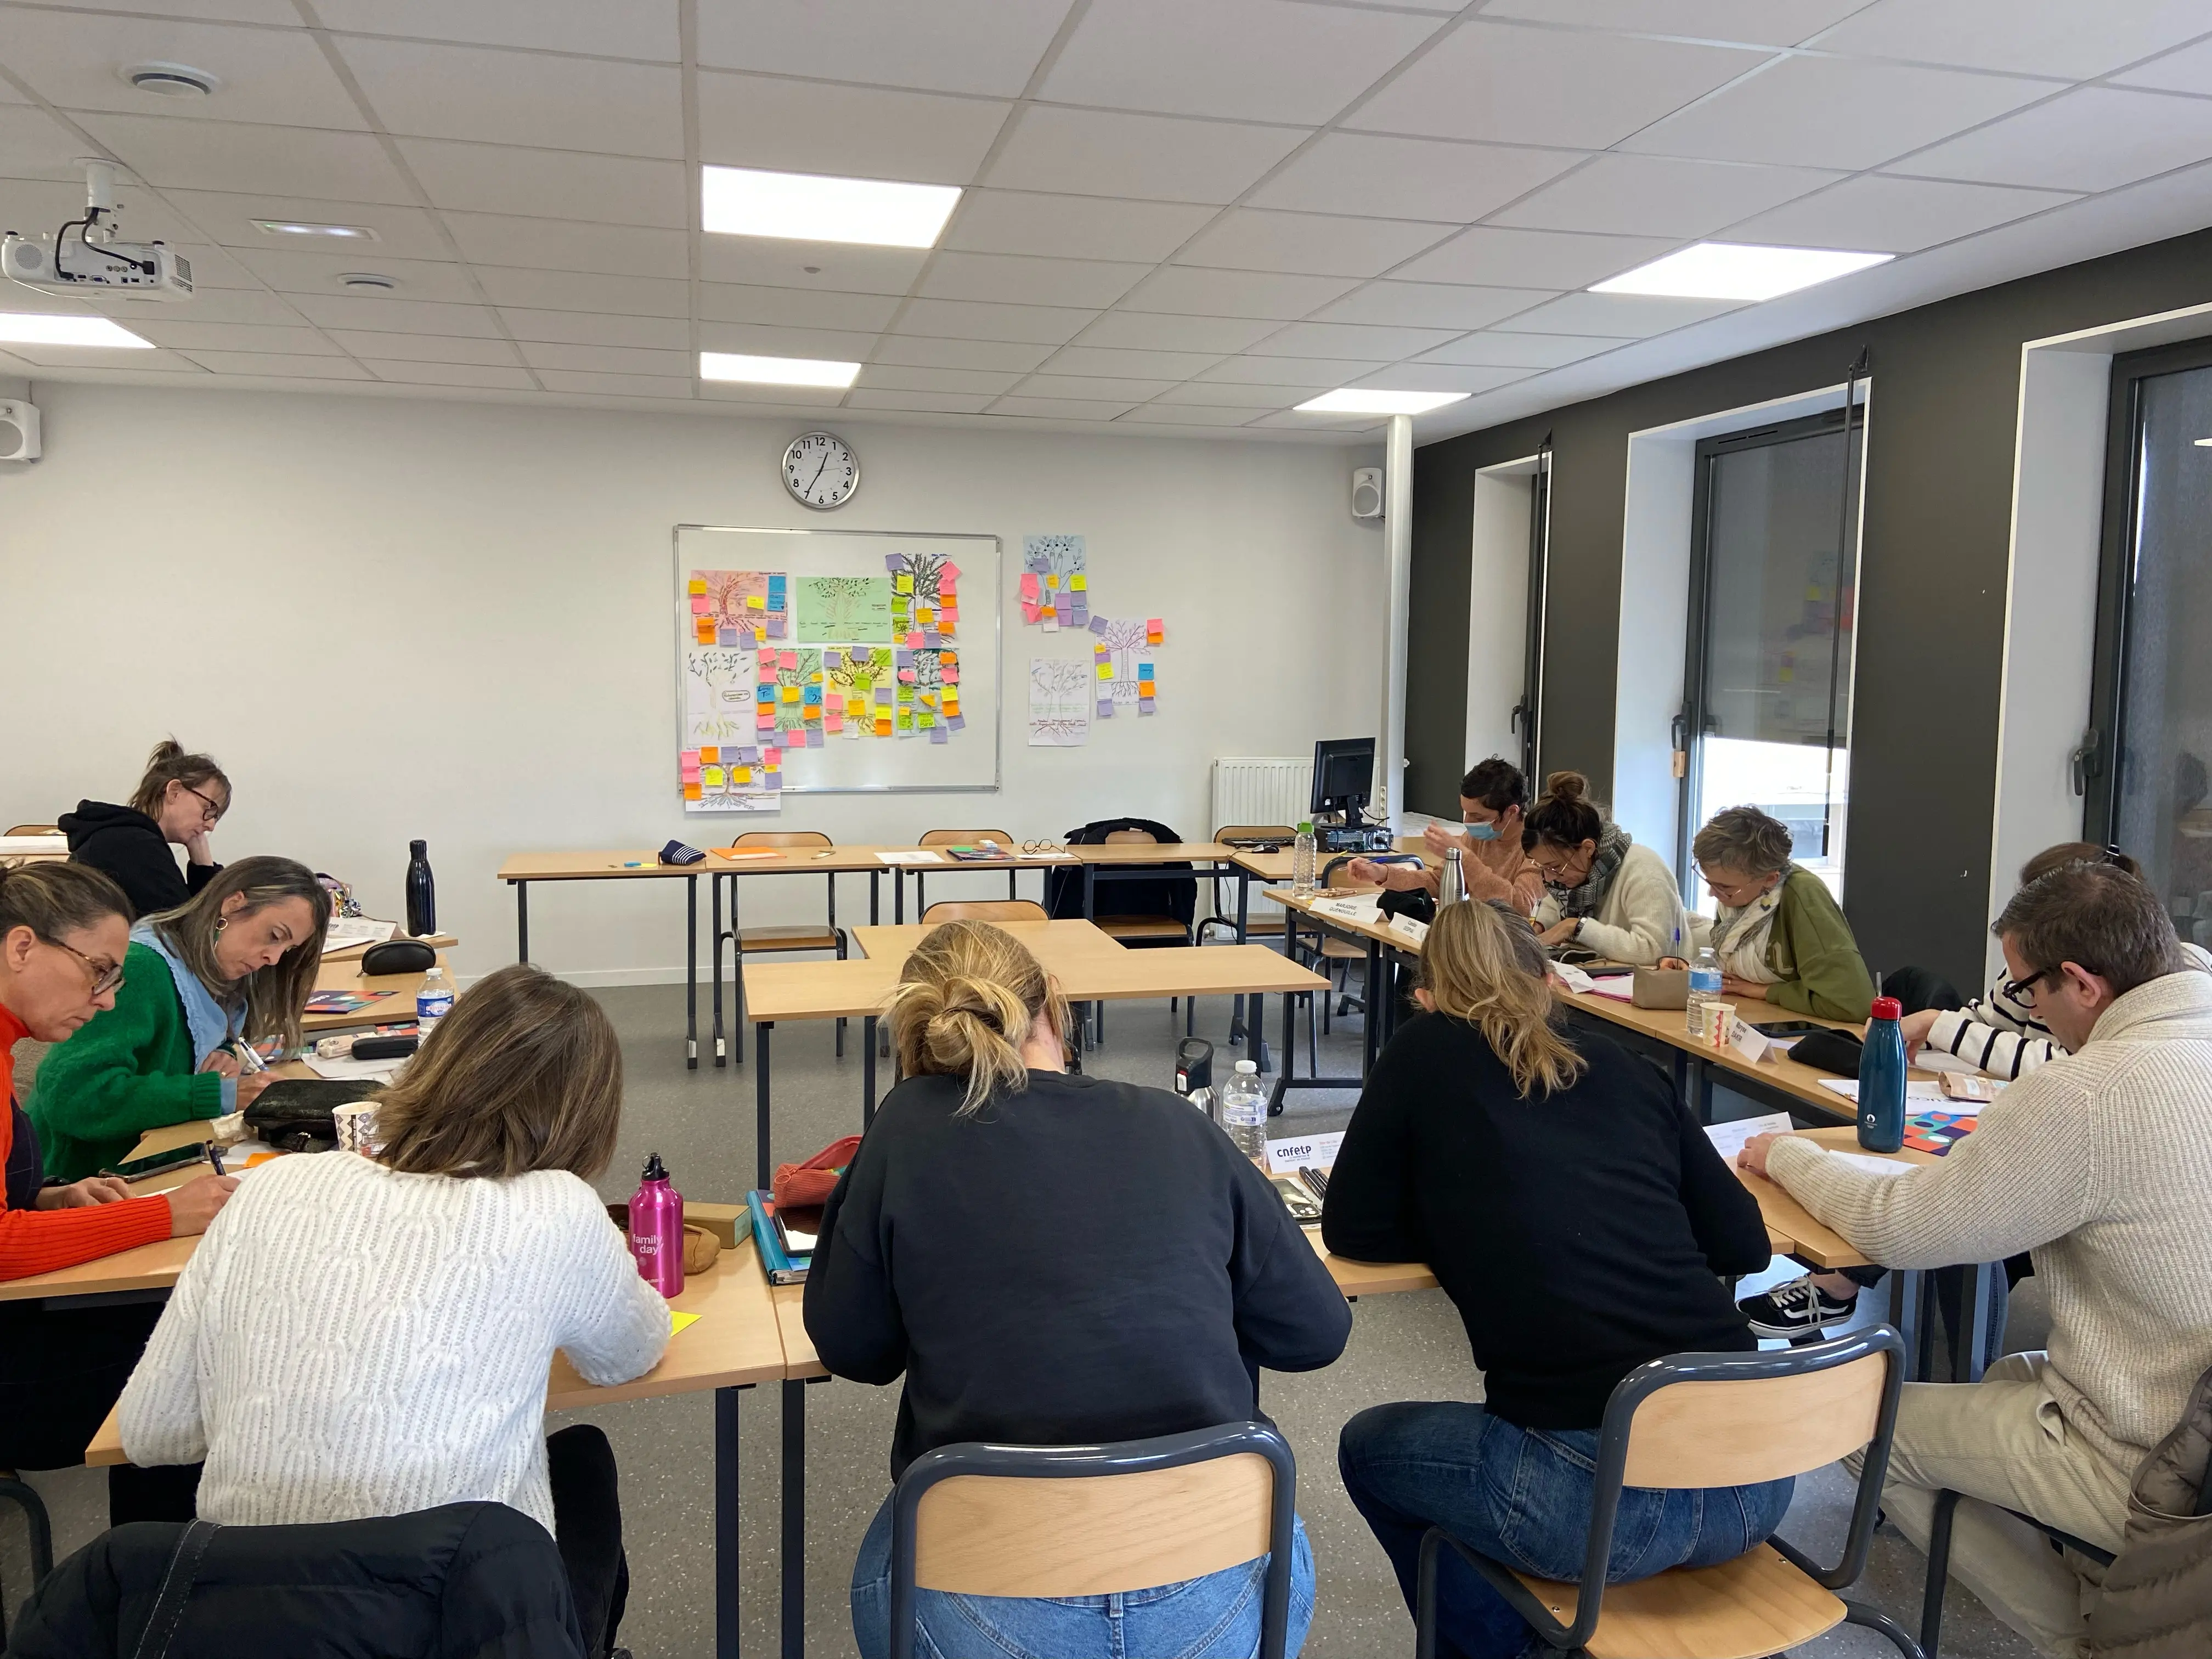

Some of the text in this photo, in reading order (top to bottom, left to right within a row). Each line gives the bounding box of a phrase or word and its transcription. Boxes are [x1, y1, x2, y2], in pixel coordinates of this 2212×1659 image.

[803, 441, 810, 449] 11
[815, 437, 825, 446] 12
[832, 442, 836, 450] 1
[792, 450, 802, 459] 10
[842, 453, 849, 461] 2
[789, 465, 794, 473] 9
[845, 467, 851, 476] 3
[793, 479, 799, 488] 8
[843, 481, 849, 489] 4
[804, 490, 810, 499] 7
[832, 492, 838, 500] 5
[819, 495, 824, 504] 6
[1335, 902, 1357, 911] MARJORIE
[1277, 1146, 1312, 1157] cnfetp
[633, 1233, 663, 1245] family
